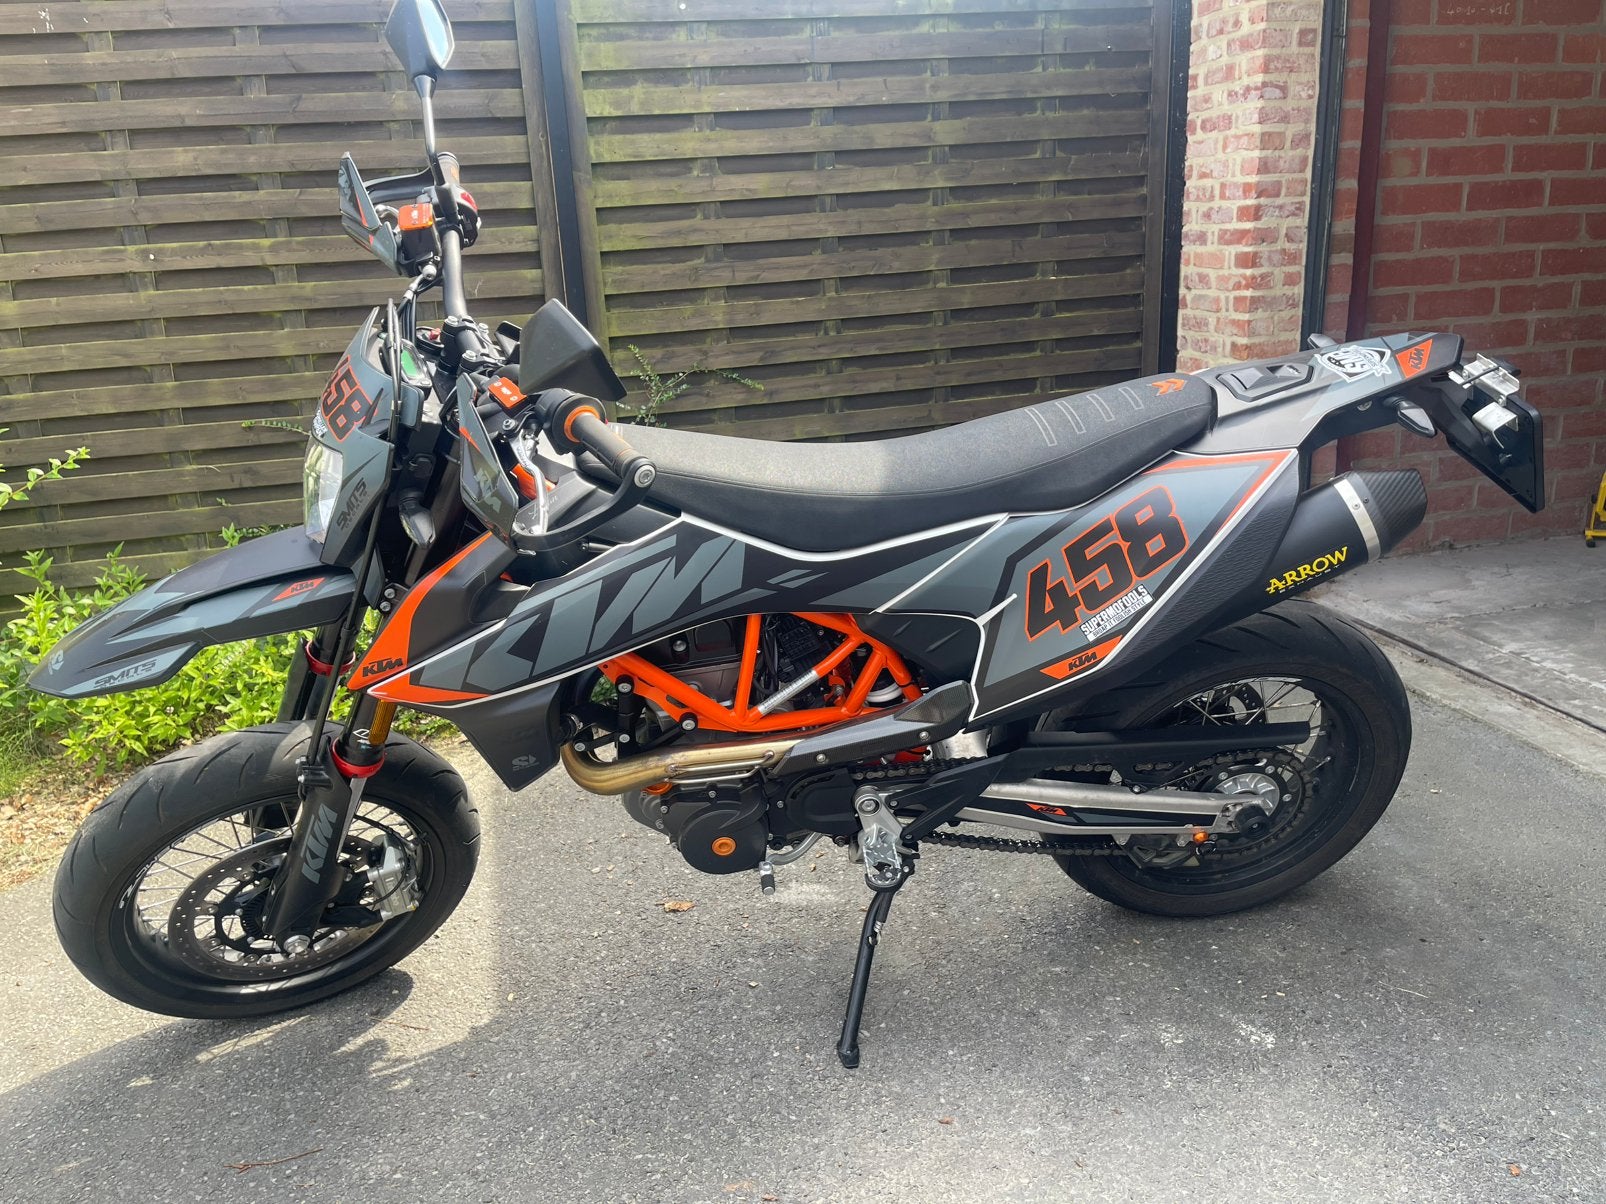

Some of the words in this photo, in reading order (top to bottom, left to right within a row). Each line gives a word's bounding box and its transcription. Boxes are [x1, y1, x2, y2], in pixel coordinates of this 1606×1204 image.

[291, 581, 314, 593] KTM
[1024, 485, 1190, 642] 458
[1265, 546, 1348, 594] ARROW
[419, 533, 745, 691] KTM
[1080, 585, 1148, 635] SUPERMOFOOLS
[93, 659, 157, 688] SMITS
[362, 657, 404, 677] KTM
[1068, 652, 1098, 671] KTM
[301, 802, 338, 884] KTM
